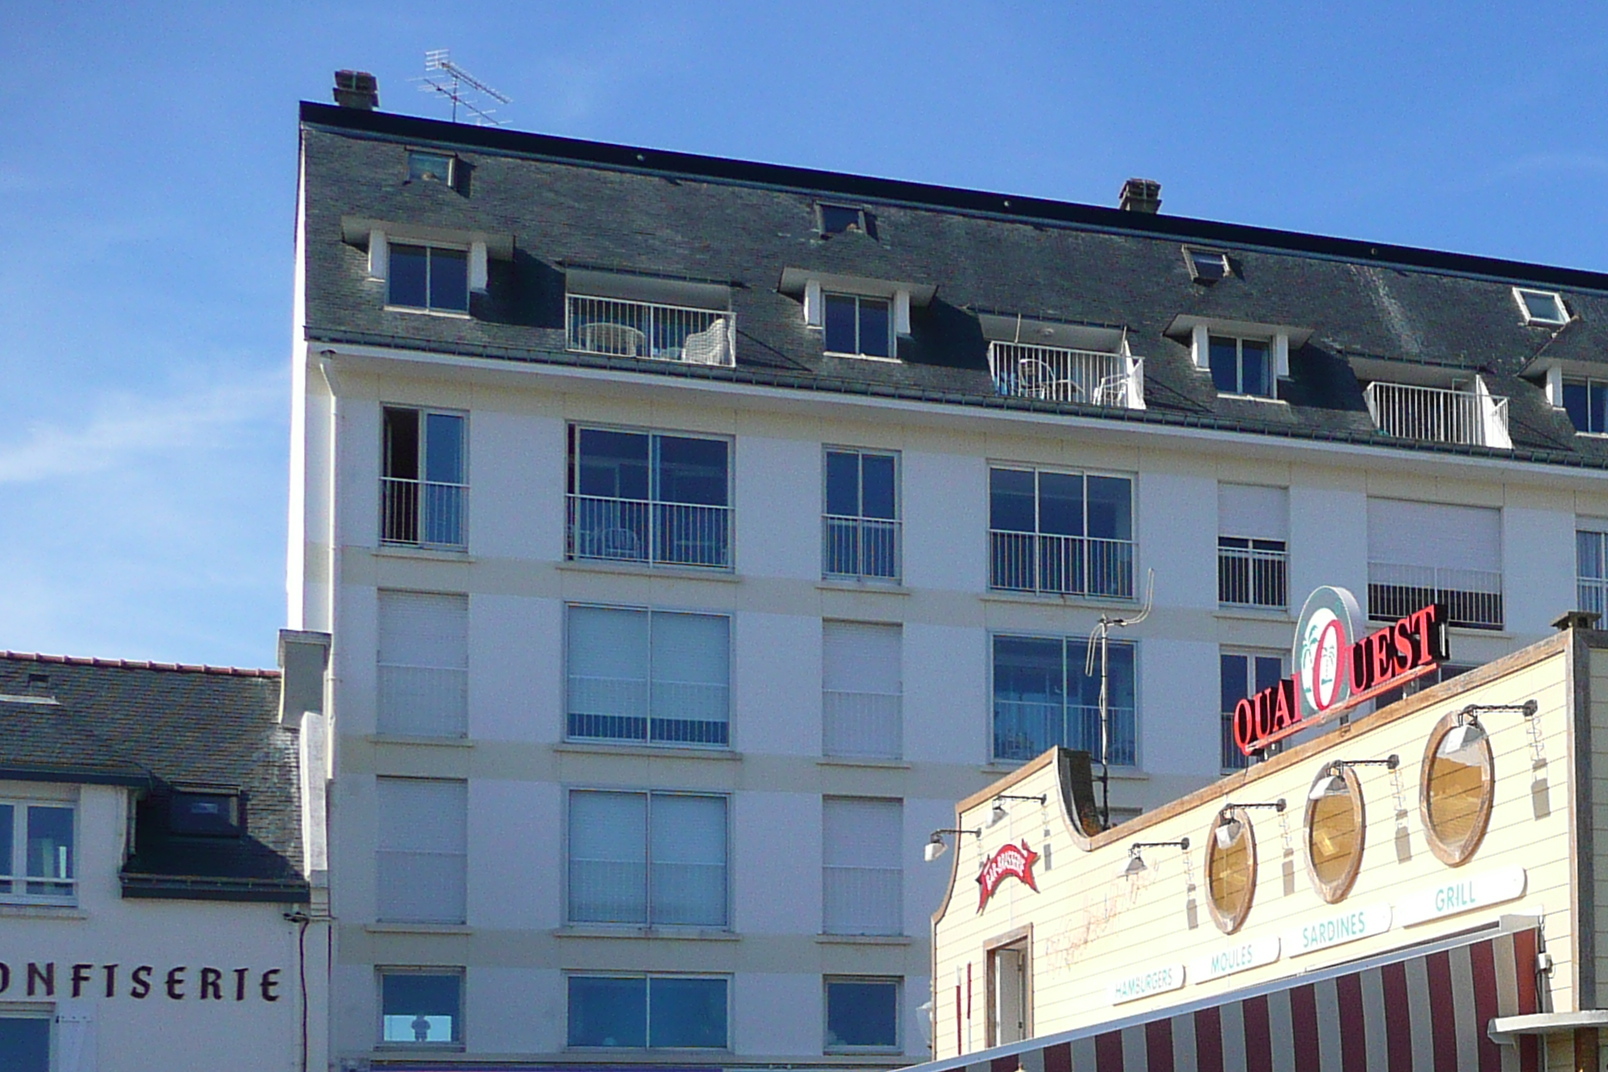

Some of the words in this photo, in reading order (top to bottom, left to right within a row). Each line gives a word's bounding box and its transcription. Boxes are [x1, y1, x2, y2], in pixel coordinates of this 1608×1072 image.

[1233, 672, 1303, 757] QUAI
[1312, 603, 1436, 712] OUEST
[1434, 880, 1477, 913] GRILL
[1302, 911, 1366, 948] SARDINES
[1210, 943, 1253, 975] MOULES
[1114, 966, 1174, 998] HAMBURGERS
